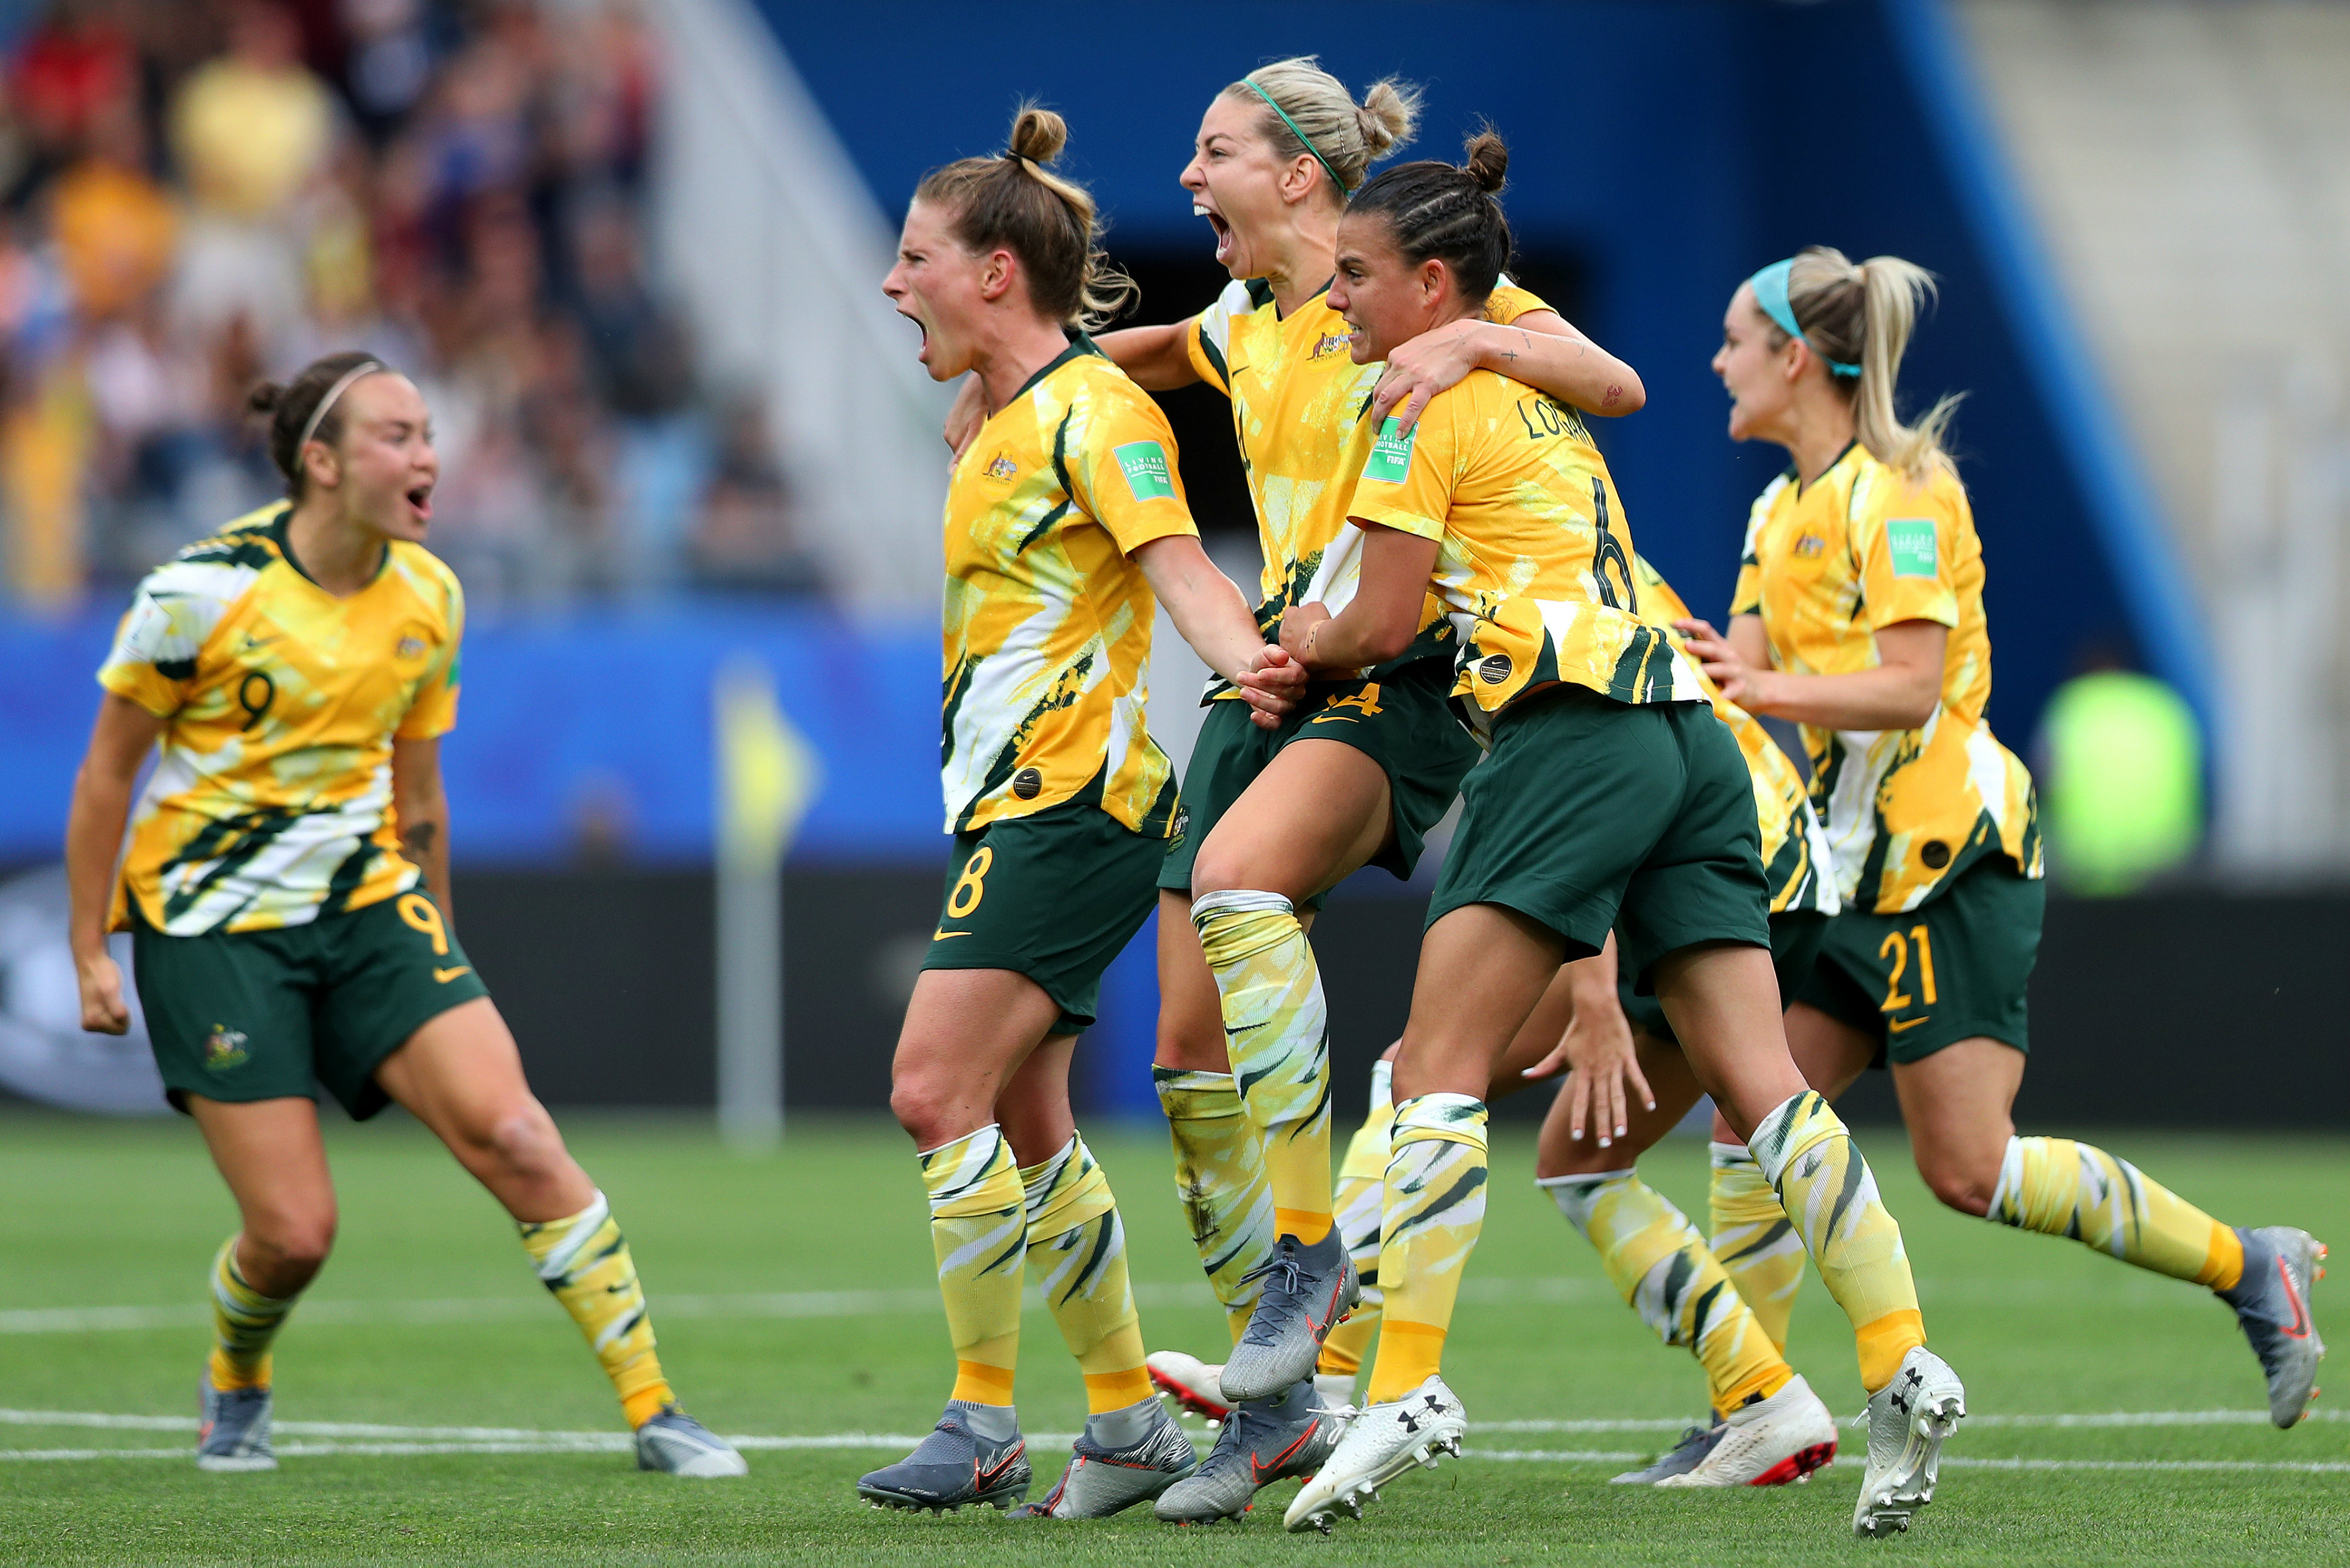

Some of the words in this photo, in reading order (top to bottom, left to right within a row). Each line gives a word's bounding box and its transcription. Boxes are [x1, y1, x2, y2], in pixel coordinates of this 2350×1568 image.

[1124, 457, 1163, 468] LIVING
[1128, 463, 1165, 473] FOOTBALL
[1386, 455, 1405, 466] FIFA
[1591, 475, 1639, 616] 6
[239, 670, 275, 733] 9
[947, 846, 993, 919] 8
[396, 892, 449, 956] 9
[1878, 923, 1938, 1013] 21
